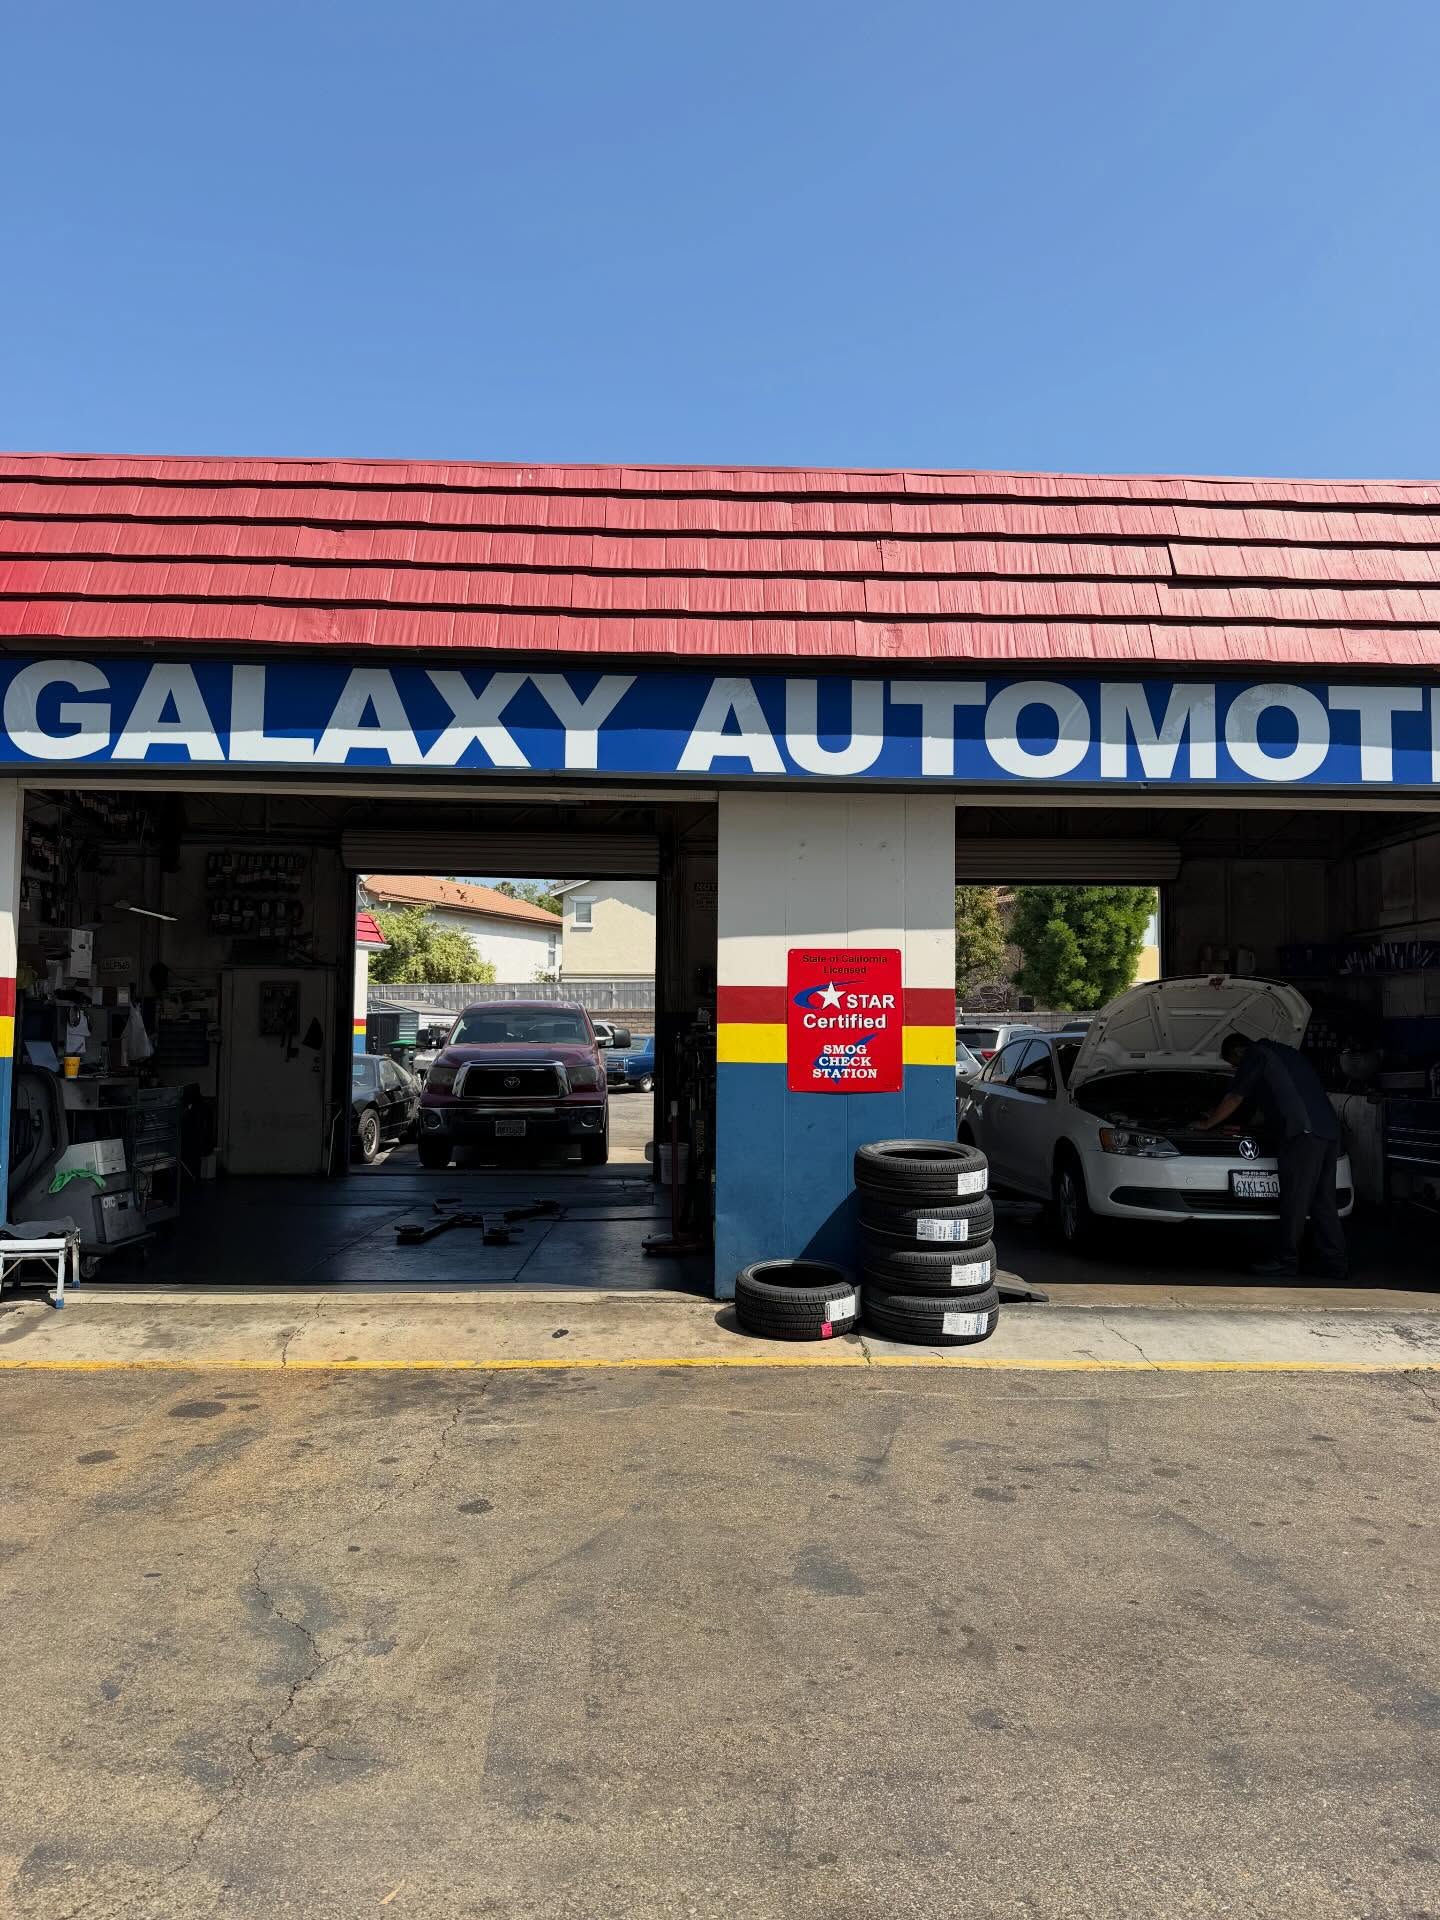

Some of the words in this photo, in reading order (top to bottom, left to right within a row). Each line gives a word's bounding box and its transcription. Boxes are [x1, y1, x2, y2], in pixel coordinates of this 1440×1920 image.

[3, 659, 638, 770] GALAXY
[802, 955, 826, 963] State
[830, 955, 839, 963] of
[841, 955, 887, 963] California
[823, 966, 867, 974] Licensed
[847, 994, 895, 1009] STAR
[803, 1013, 887, 1029] Certified
[823, 1044, 867, 1054] SMOG
[818, 1056, 871, 1067] CHECK
[812, 1068, 878, 1079] STATION
